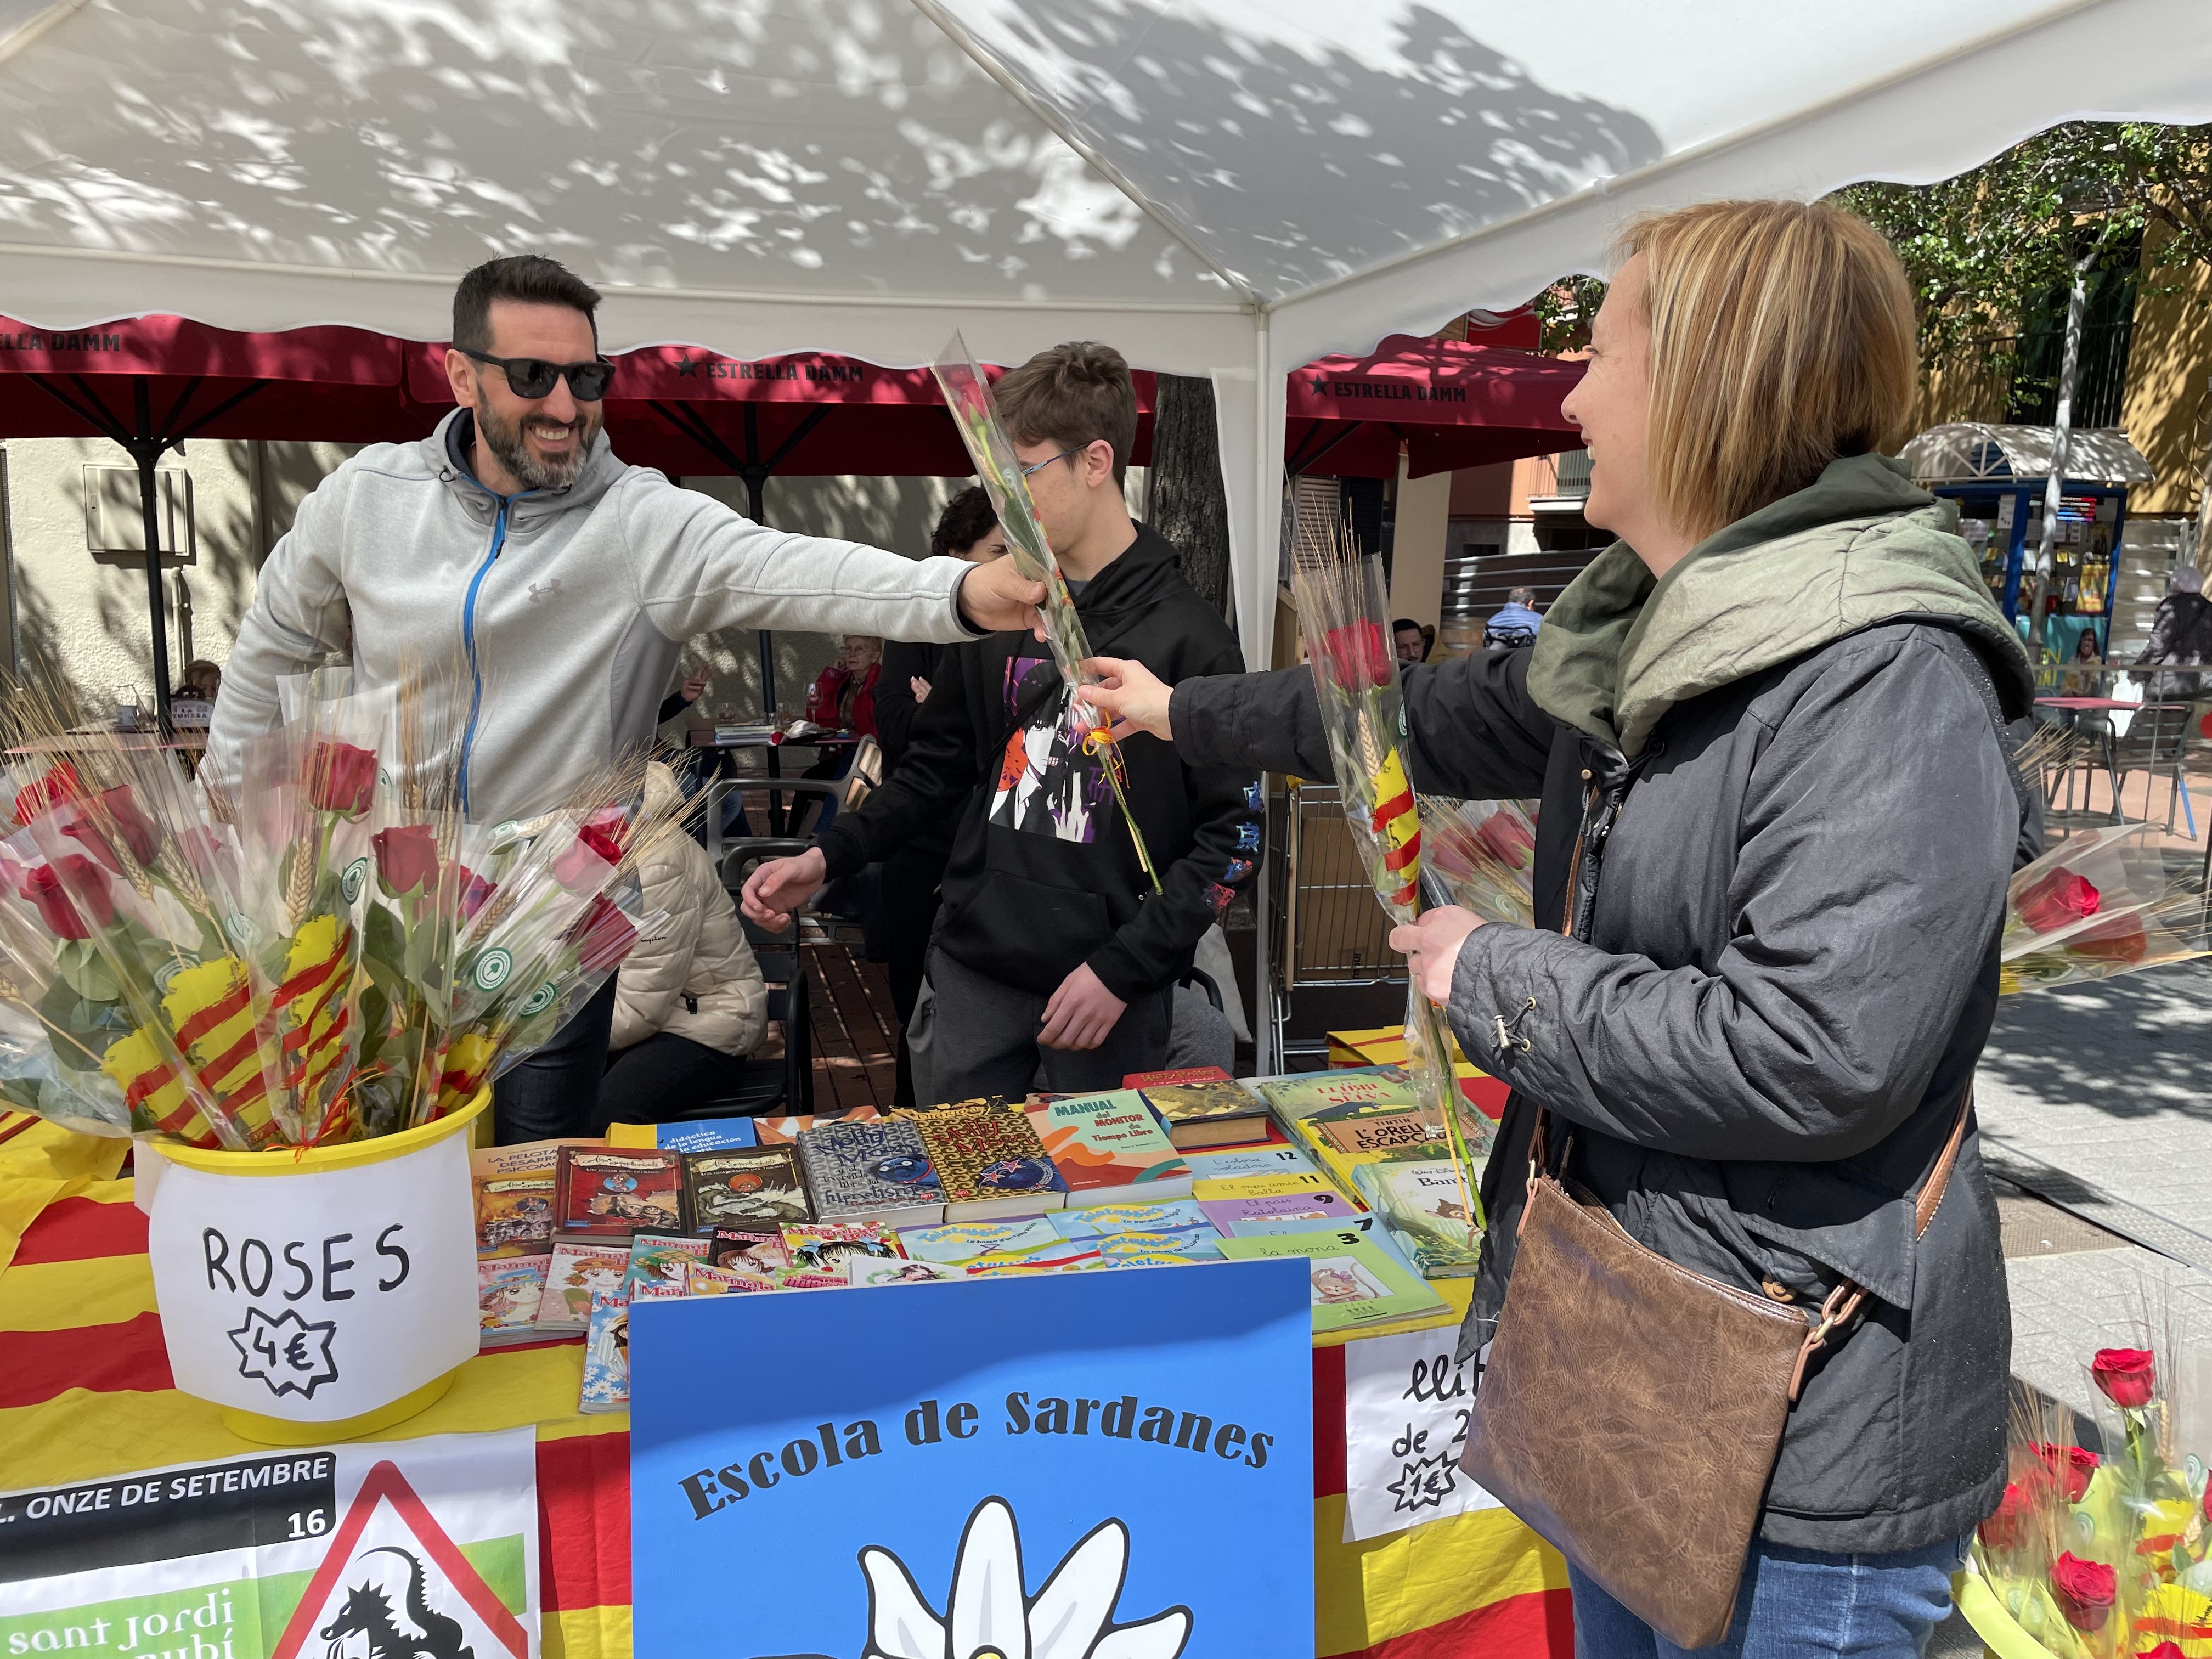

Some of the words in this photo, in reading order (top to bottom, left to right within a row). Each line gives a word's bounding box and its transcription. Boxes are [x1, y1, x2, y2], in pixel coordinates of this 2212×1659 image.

[51, 333, 120, 351] DAMM
[706, 363, 798, 380] ESTRELLA
[805, 364, 864, 382] DAMM
[1335, 382, 1412, 400] ESTRELLA
[1417, 386, 1466, 402] DAMM
[1140, 1073, 1176, 1082] Harry
[1175, 1070, 1218, 1080] Potter
[1054, 1099, 1117, 1116] MANUAL
[1094, 1114, 1144, 1127] MONITOR
[1373, 1118, 1411, 1126] TINTIN
[933, 1120, 999, 1142] Molly
[1128, 1129, 1153, 1137] Libre
[689, 1135, 723, 1145] lengua
[814, 1126, 884, 1155] Molly
[953, 1135, 1036, 1155] Moon
[509, 1149, 558, 1160] PELOTA
[837, 1144, 920, 1167] Moon
[1276, 1152, 1297, 1160] 12
[1214, 1163, 1273, 1171] voladora
[1299, 1175, 1320, 1184] 11
[1314, 1195, 1334, 1204] 9
[1353, 1217, 1373, 1231] 7
[840, 1232, 878, 1243] Boy
[1337, 1233, 1360, 1244] 3
[1287, 1244, 1339, 1255] mona
[203, 1223, 409, 1301] ROSES
[253, 1326, 315, 1370] 4€
[1392, 1423, 1429, 1458] de
[678, 1417, 882, 1521] Escola
[904, 1400, 979, 1446] de
[1005, 1391, 1274, 1469] Sardanes
[26, 1488, 112, 1519] ONZE
[121, 1481, 161, 1507] DE
[169, 1457, 329, 1499] SETEMBRE
[287, 1509, 326, 1538] 16
[8, 1617, 112, 1655] sant
